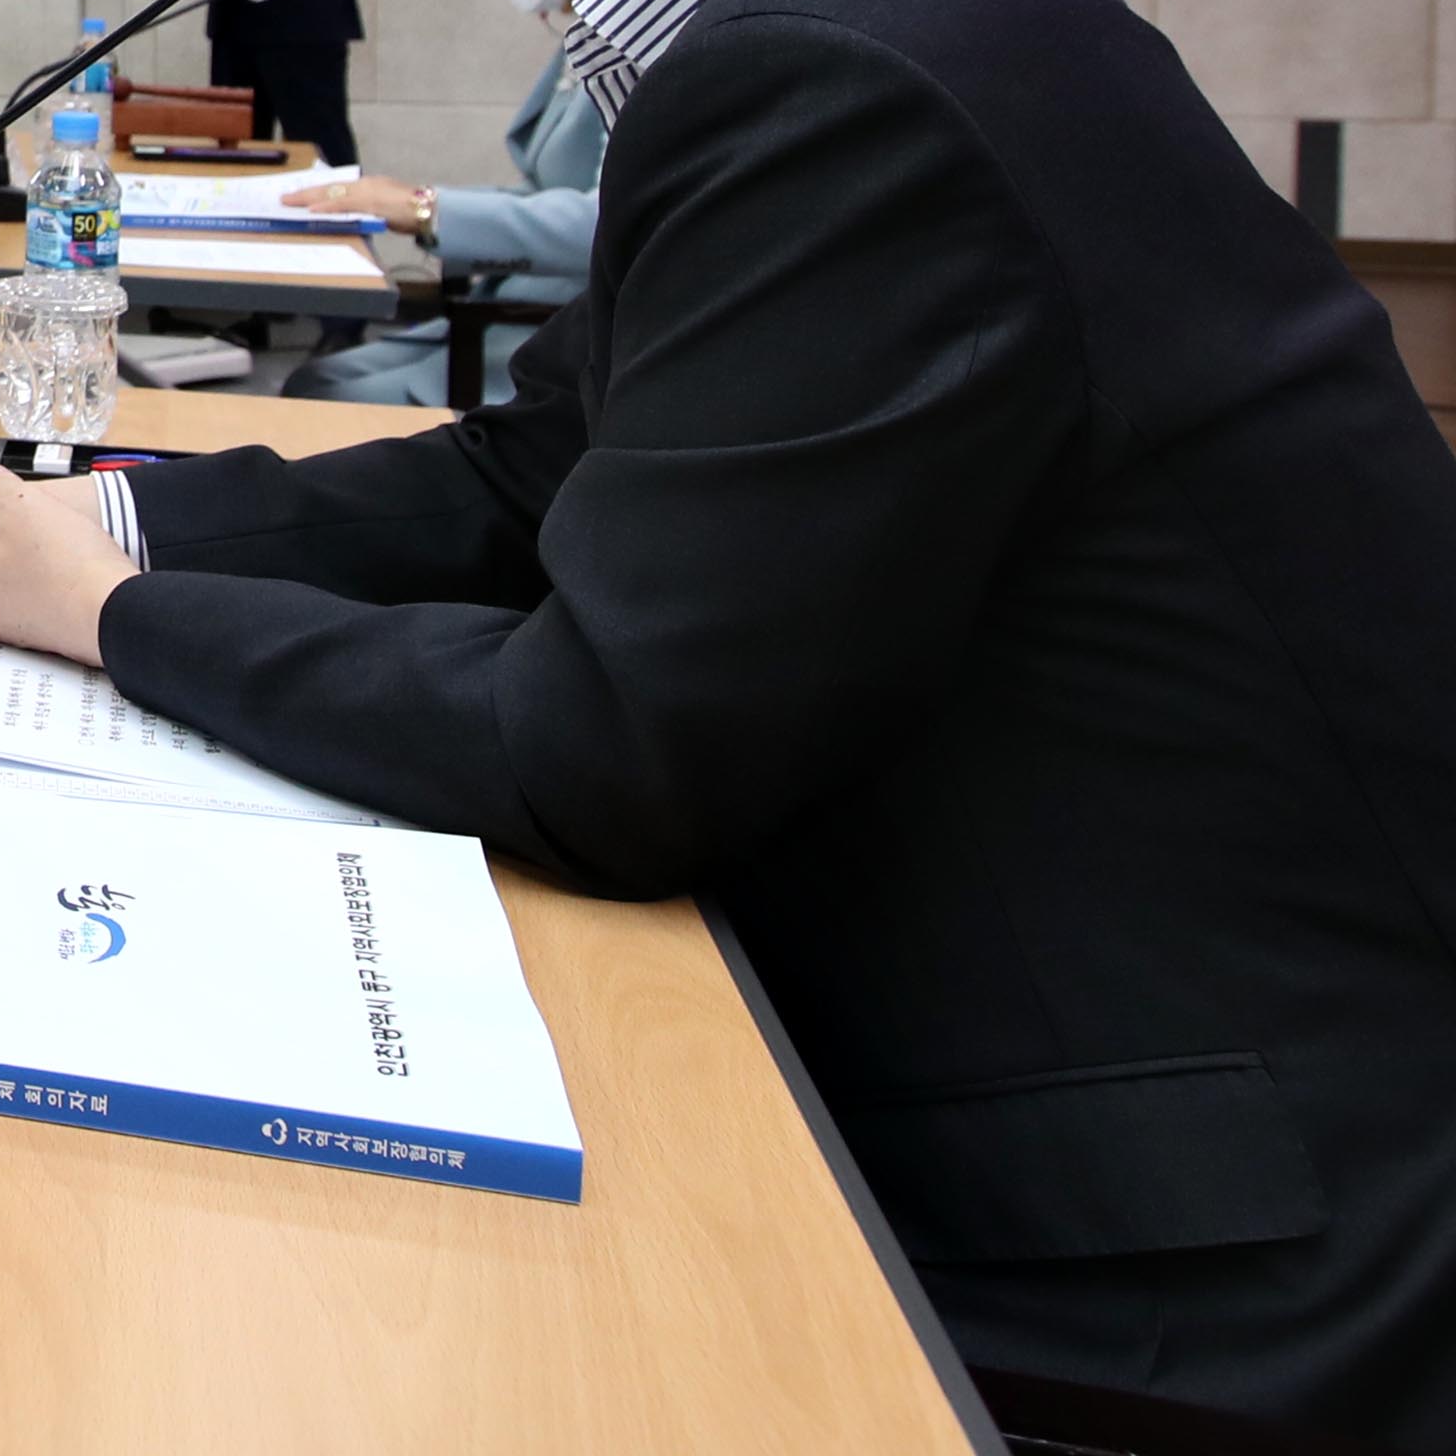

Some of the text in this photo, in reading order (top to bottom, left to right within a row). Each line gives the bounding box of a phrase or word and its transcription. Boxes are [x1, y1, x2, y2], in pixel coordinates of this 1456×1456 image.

[73, 215, 96, 233] 50
[337, 852, 410, 1078] 인천광역시 동구 지역사회보장협의체
[24, 1084, 108, 1116] 회의자료
[295, 1127, 466, 1170] 지역사회보장협의체
